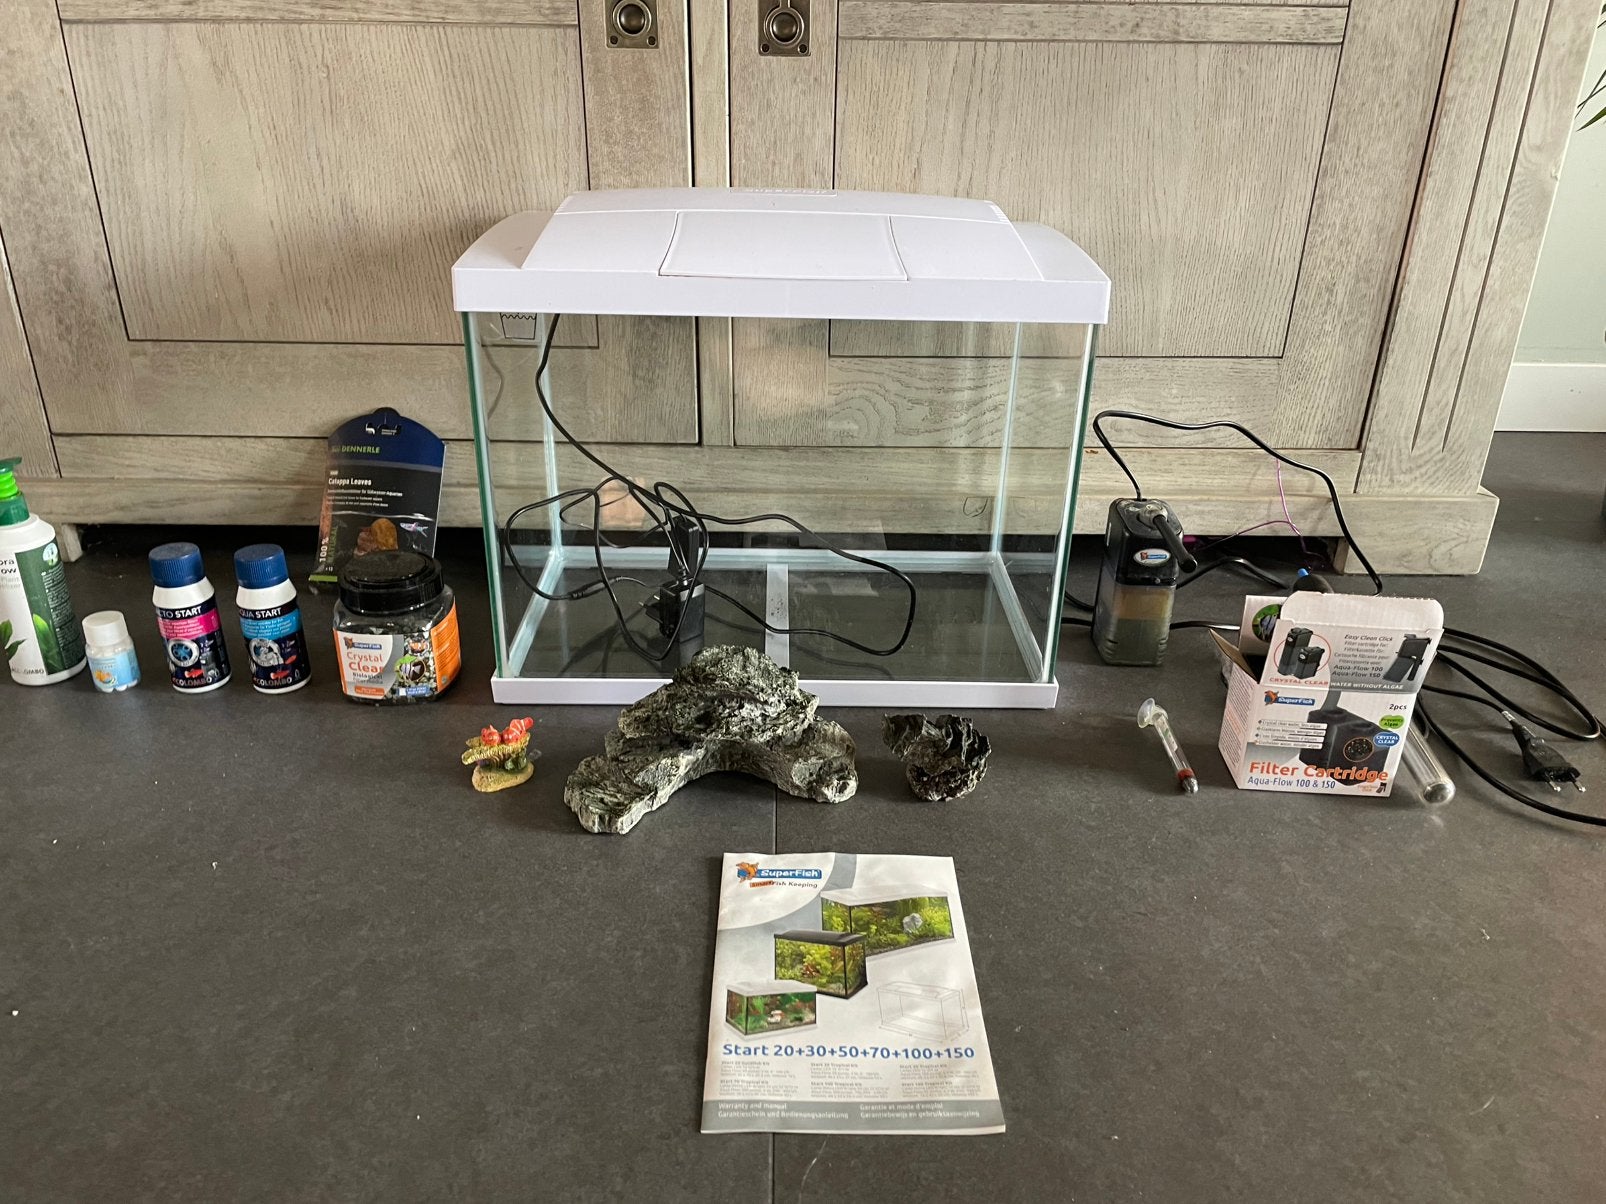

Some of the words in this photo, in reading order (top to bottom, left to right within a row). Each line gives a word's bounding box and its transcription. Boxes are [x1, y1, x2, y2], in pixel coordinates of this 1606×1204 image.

[341, 445, 381, 454] DENNERLE
[328, 477, 350, 486] Catappa
[350, 477, 372, 485] Leaves
[319, 545, 328, 563] 100
[175, 606, 202, 619] START
[256, 607, 282, 619] START
[346, 651, 382, 663] Crystal
[348, 662, 383, 673] Clear
[1278, 697, 1313, 705] SuperFish
[1249, 762, 1299, 776] Filter
[1304, 764, 1389, 783] Cartridge
[1247, 776, 1293, 786] Aqua-Flow
[1296, 779, 1310, 788] 100
[1312, 780, 1318, 788] &
[1320, 780, 1336, 789] 150
[760, 869, 818, 878] SuperFish
[788, 881, 818, 889] Keeping
[723, 1044, 769, 1056] Start
[774, 1045, 975, 1060] 20+30+50+70+100+150
[718, 1102, 749, 1110] Warranty
[915, 1102, 944, 1111] d'emploi
[780, 1111, 848, 1120] Bedienungsanleitung
